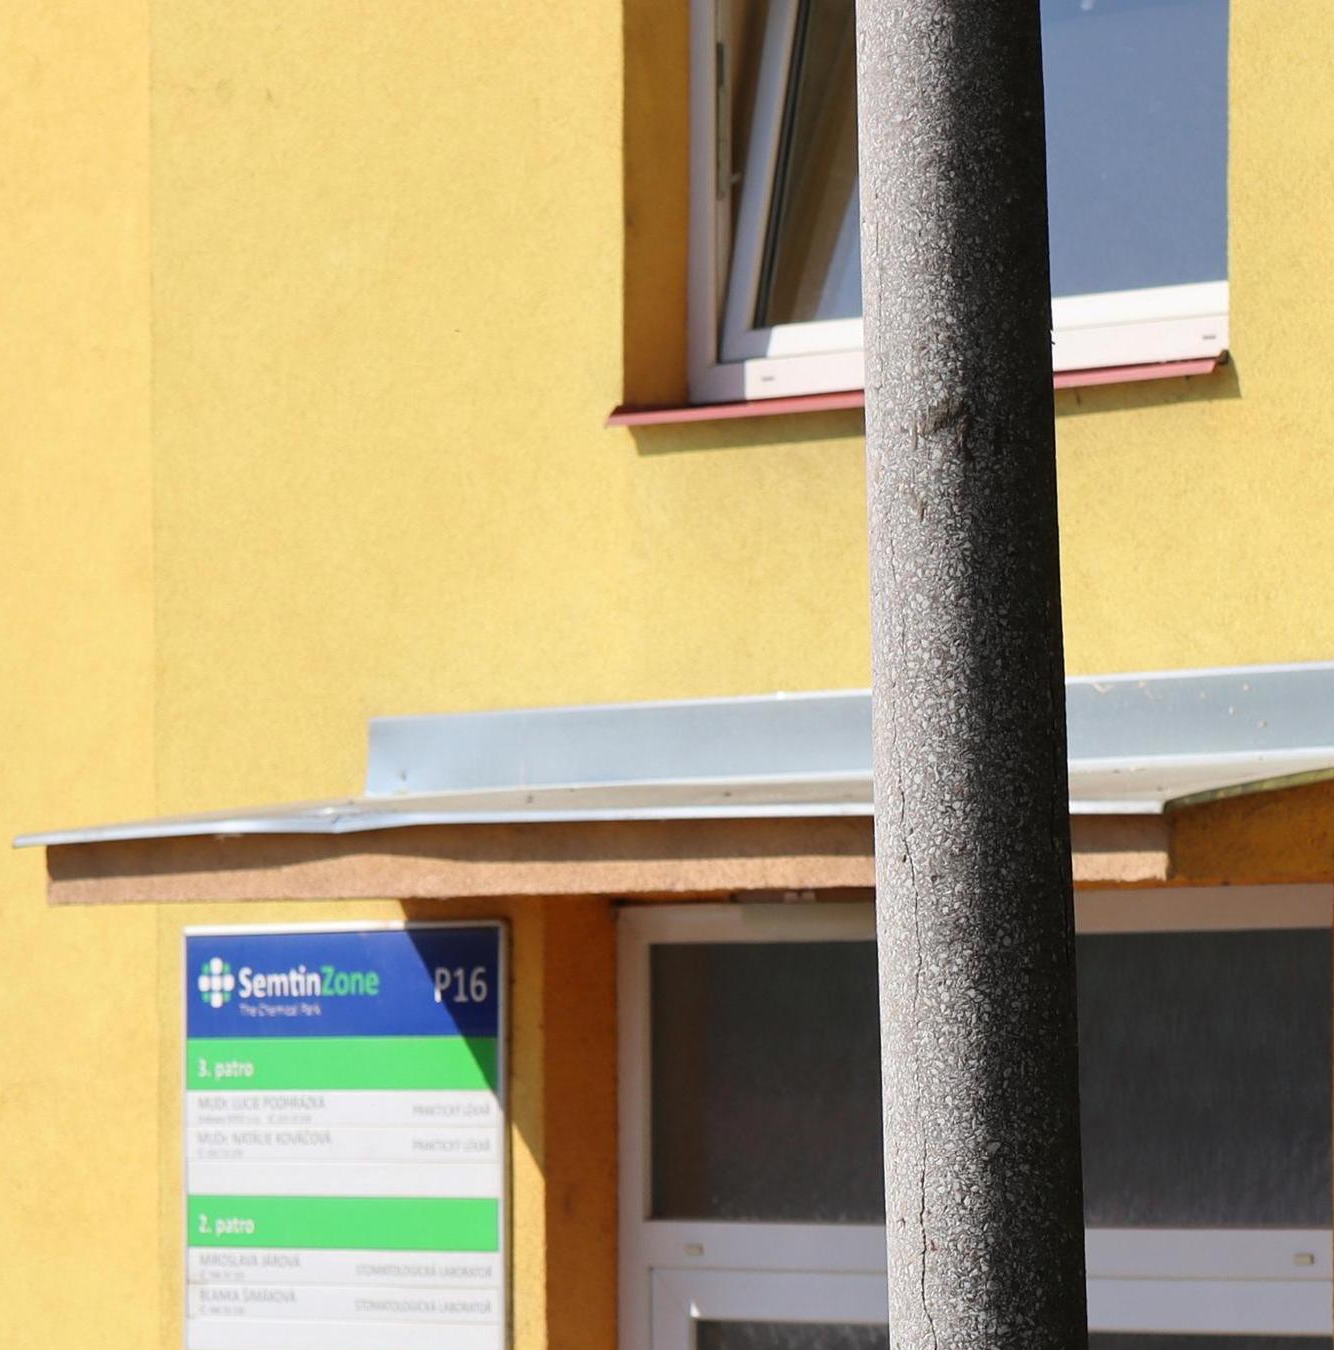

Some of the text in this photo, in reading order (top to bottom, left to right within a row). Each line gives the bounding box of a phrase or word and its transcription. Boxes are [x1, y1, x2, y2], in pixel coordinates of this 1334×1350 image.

[238, 964, 380, 998] SemtinZone
[434, 966, 487, 1002] P16
[197, 1058, 254, 1080] 3. patro
[198, 1214, 254, 1236] 2. patro
